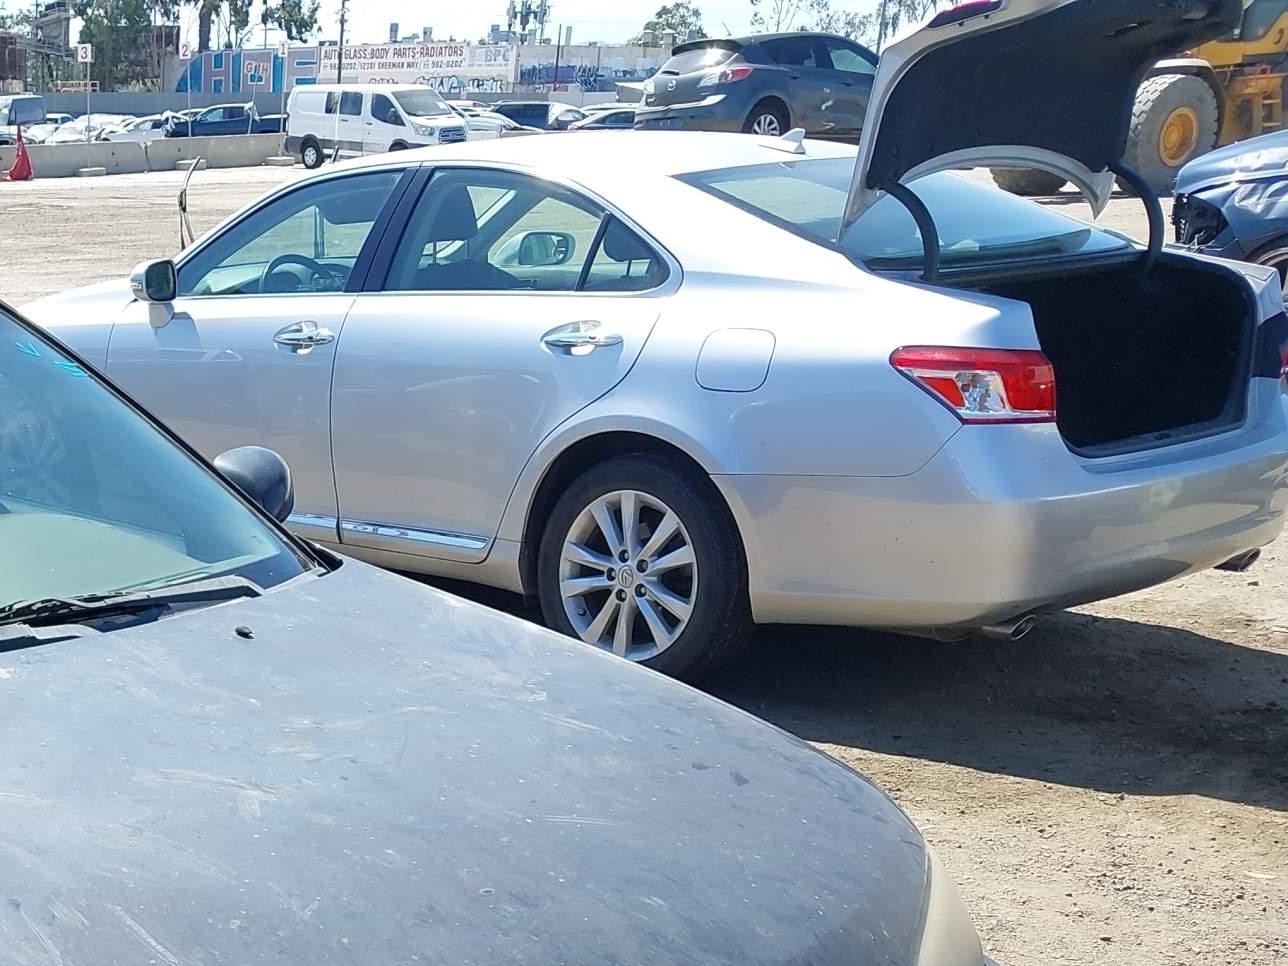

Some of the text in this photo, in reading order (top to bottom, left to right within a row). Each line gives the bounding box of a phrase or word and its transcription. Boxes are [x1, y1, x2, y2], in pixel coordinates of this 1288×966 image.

[80, 46, 88, 60] 3
[181, 44, 188, 58] 2
[281, 44, 286, 55] 1
